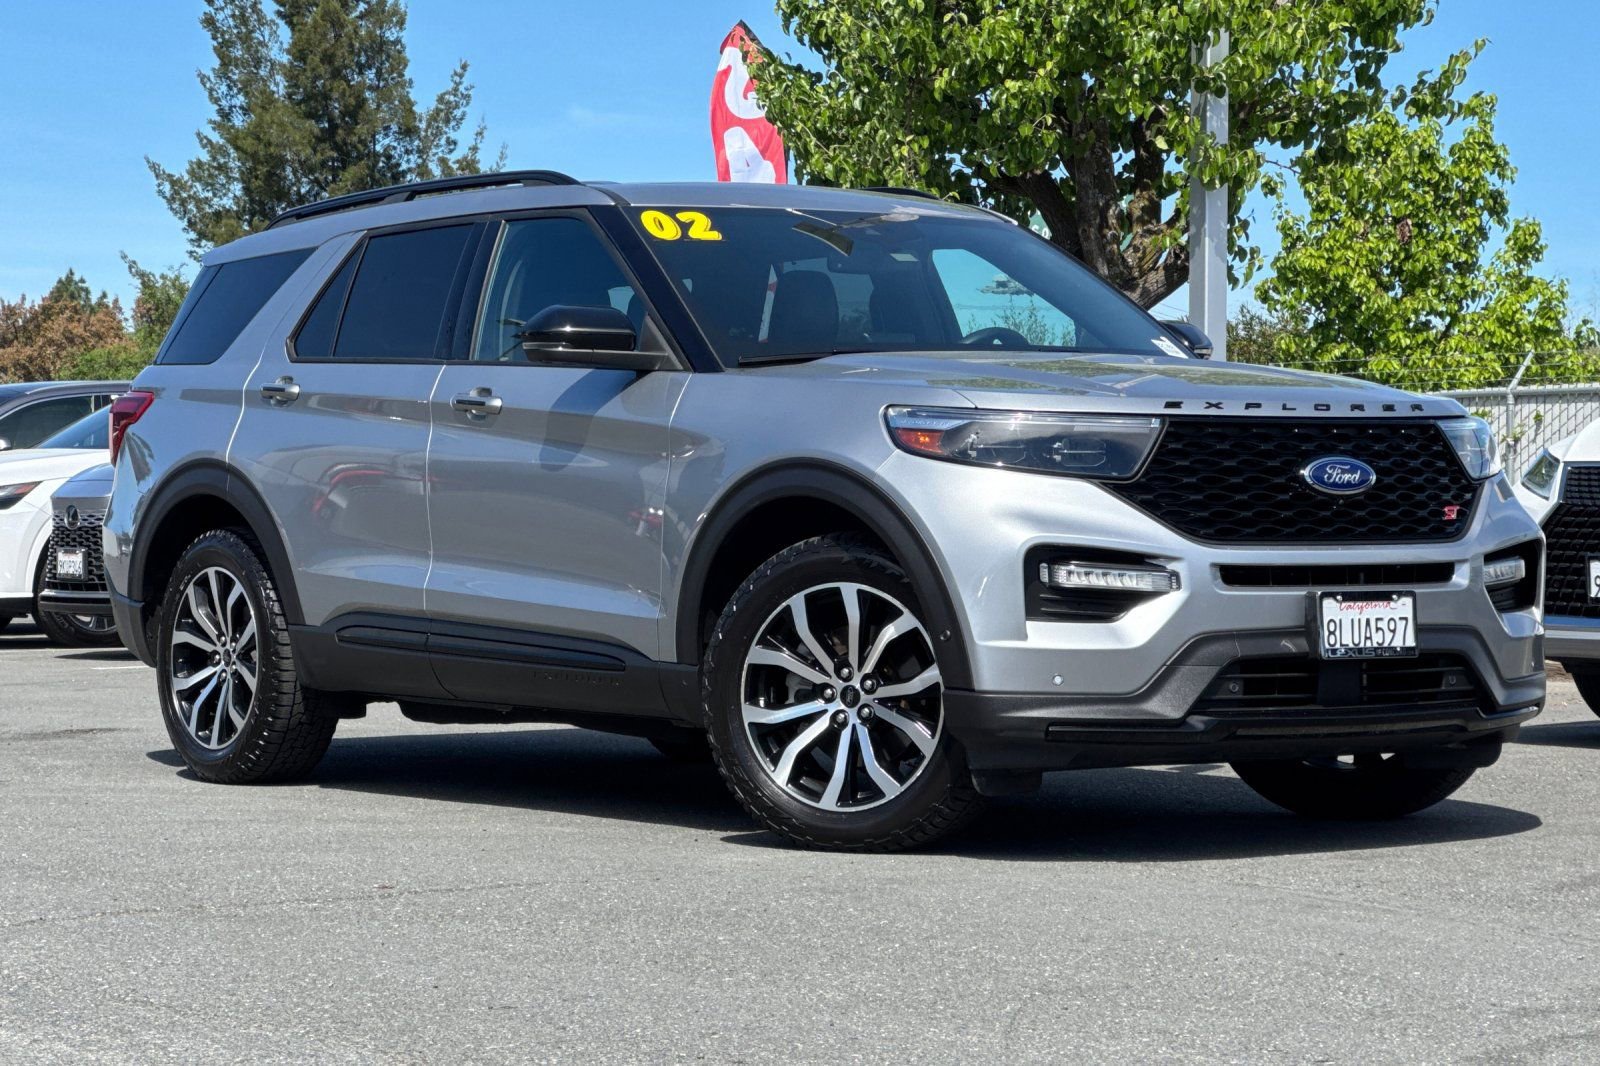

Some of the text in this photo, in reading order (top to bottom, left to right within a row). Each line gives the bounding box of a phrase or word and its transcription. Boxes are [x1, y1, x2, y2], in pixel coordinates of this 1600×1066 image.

[641, 210, 722, 240] 02
[1163, 401, 1424, 412] EXPLORER
[1324, 464, 1360, 484] Ford
[1327, 617, 1408, 648] 8LUA597
